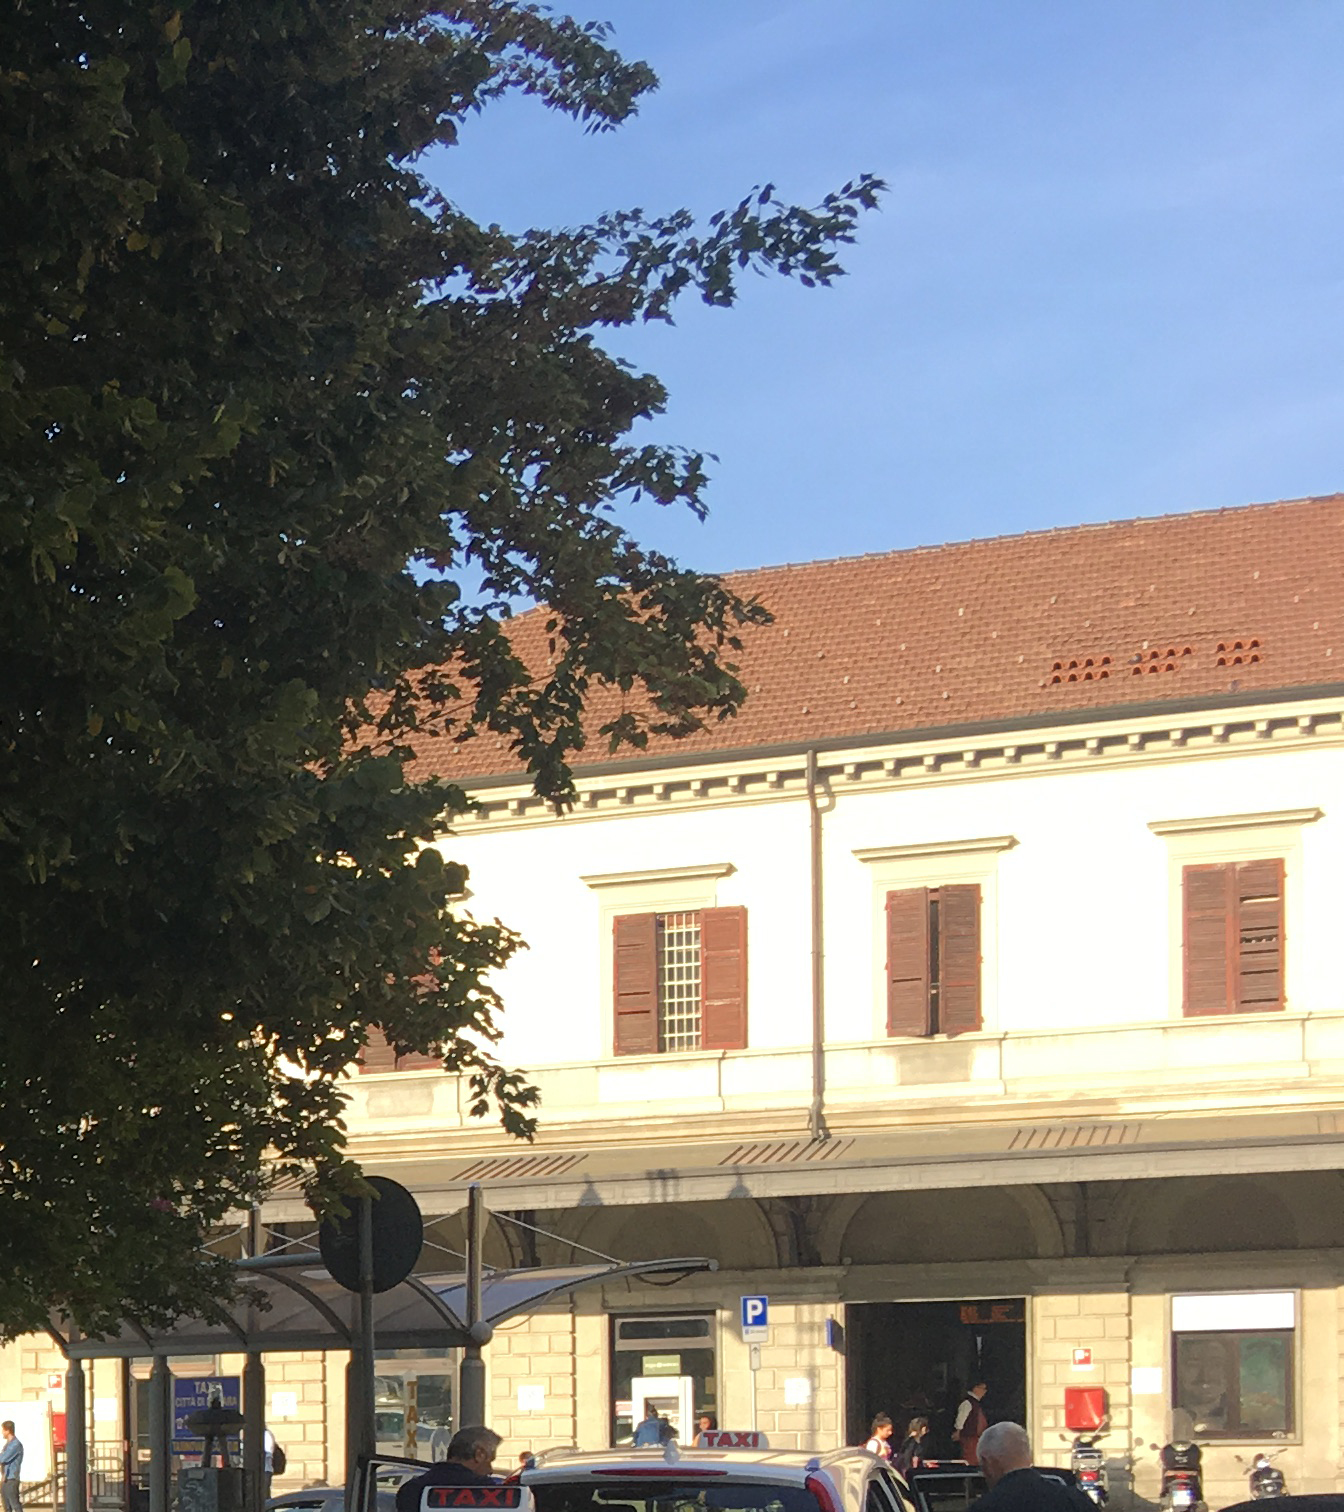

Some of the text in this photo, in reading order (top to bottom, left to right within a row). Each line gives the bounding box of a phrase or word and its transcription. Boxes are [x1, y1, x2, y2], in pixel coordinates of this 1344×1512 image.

[746, 1299, 763, 1325] P
[703, 1432, 760, 1448] TAXI
[433, 1488, 515, 1507] TAXI
